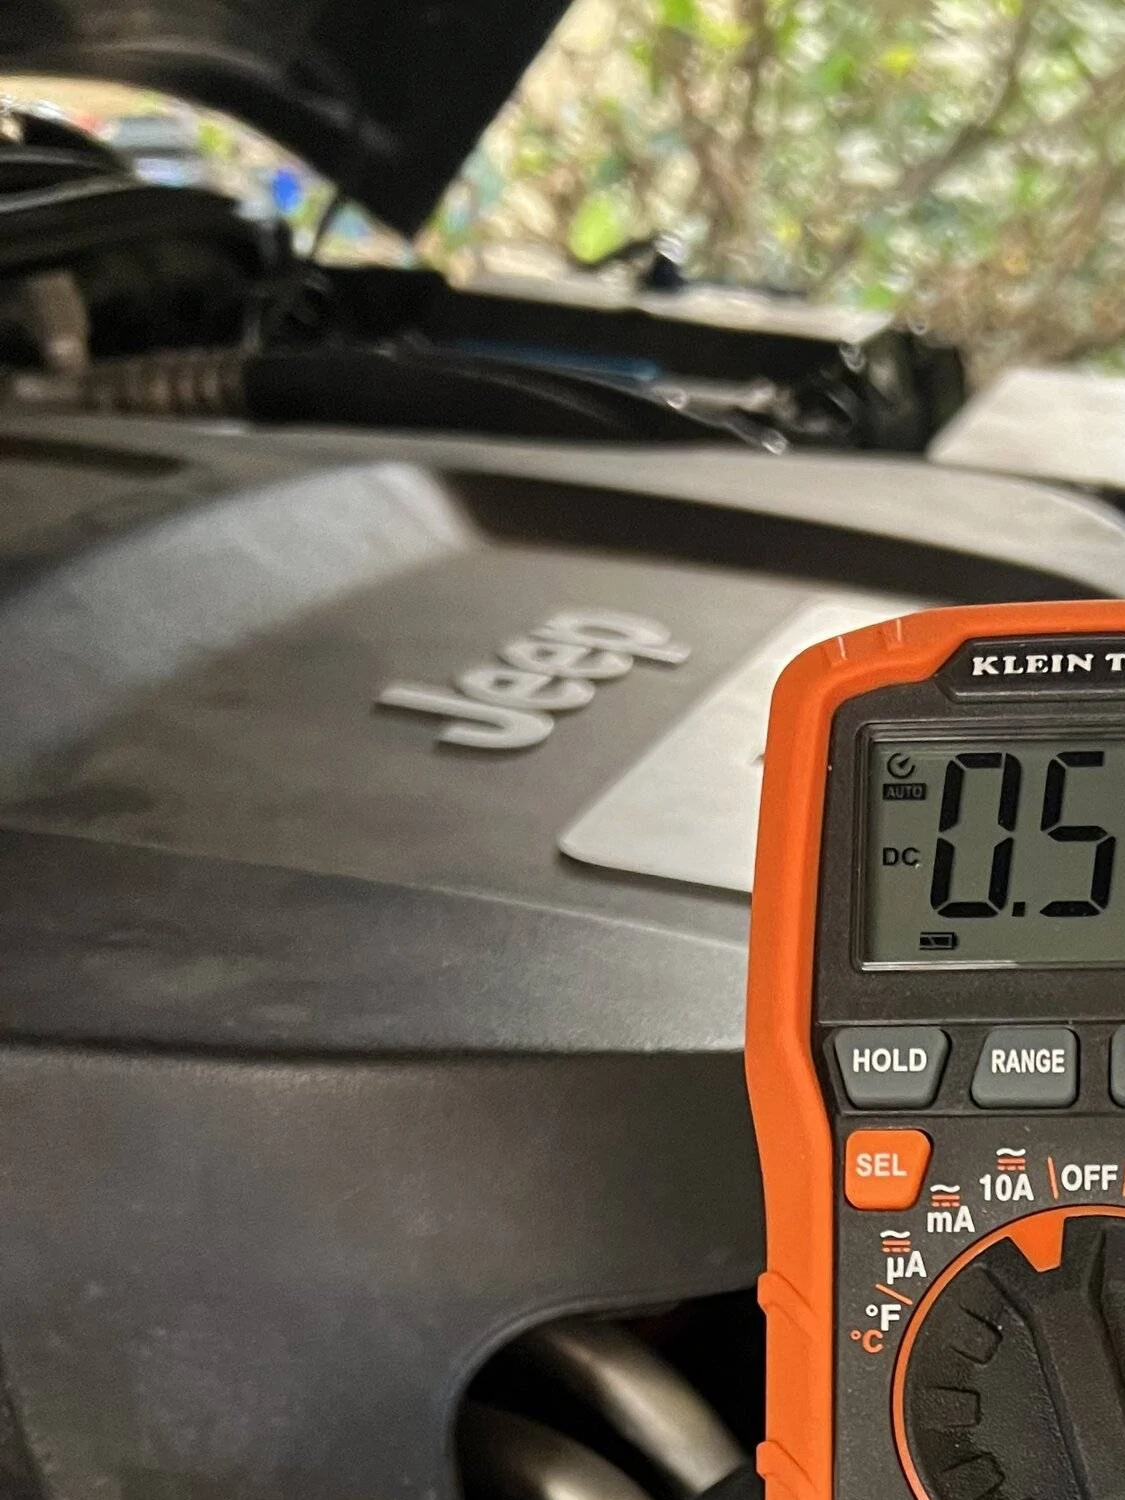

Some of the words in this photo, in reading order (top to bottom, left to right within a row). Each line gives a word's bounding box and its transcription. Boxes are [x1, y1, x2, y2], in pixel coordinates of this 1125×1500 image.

[971, 655, 1096, 676] KLEIN
[380, 611, 692, 750] Jeep
[885, 785, 924, 799] AUTO
[882, 847, 920, 867] DC
[853, 1048, 927, 1073] HOLD
[991, 1049, 1065, 1074] RANGE
[855, 1153, 907, 1178] SEL
[980, 1175, 1034, 1202] 10A
[1061, 1165, 1118, 1192] OFF
[927, 1206, 975, 1233] mA
